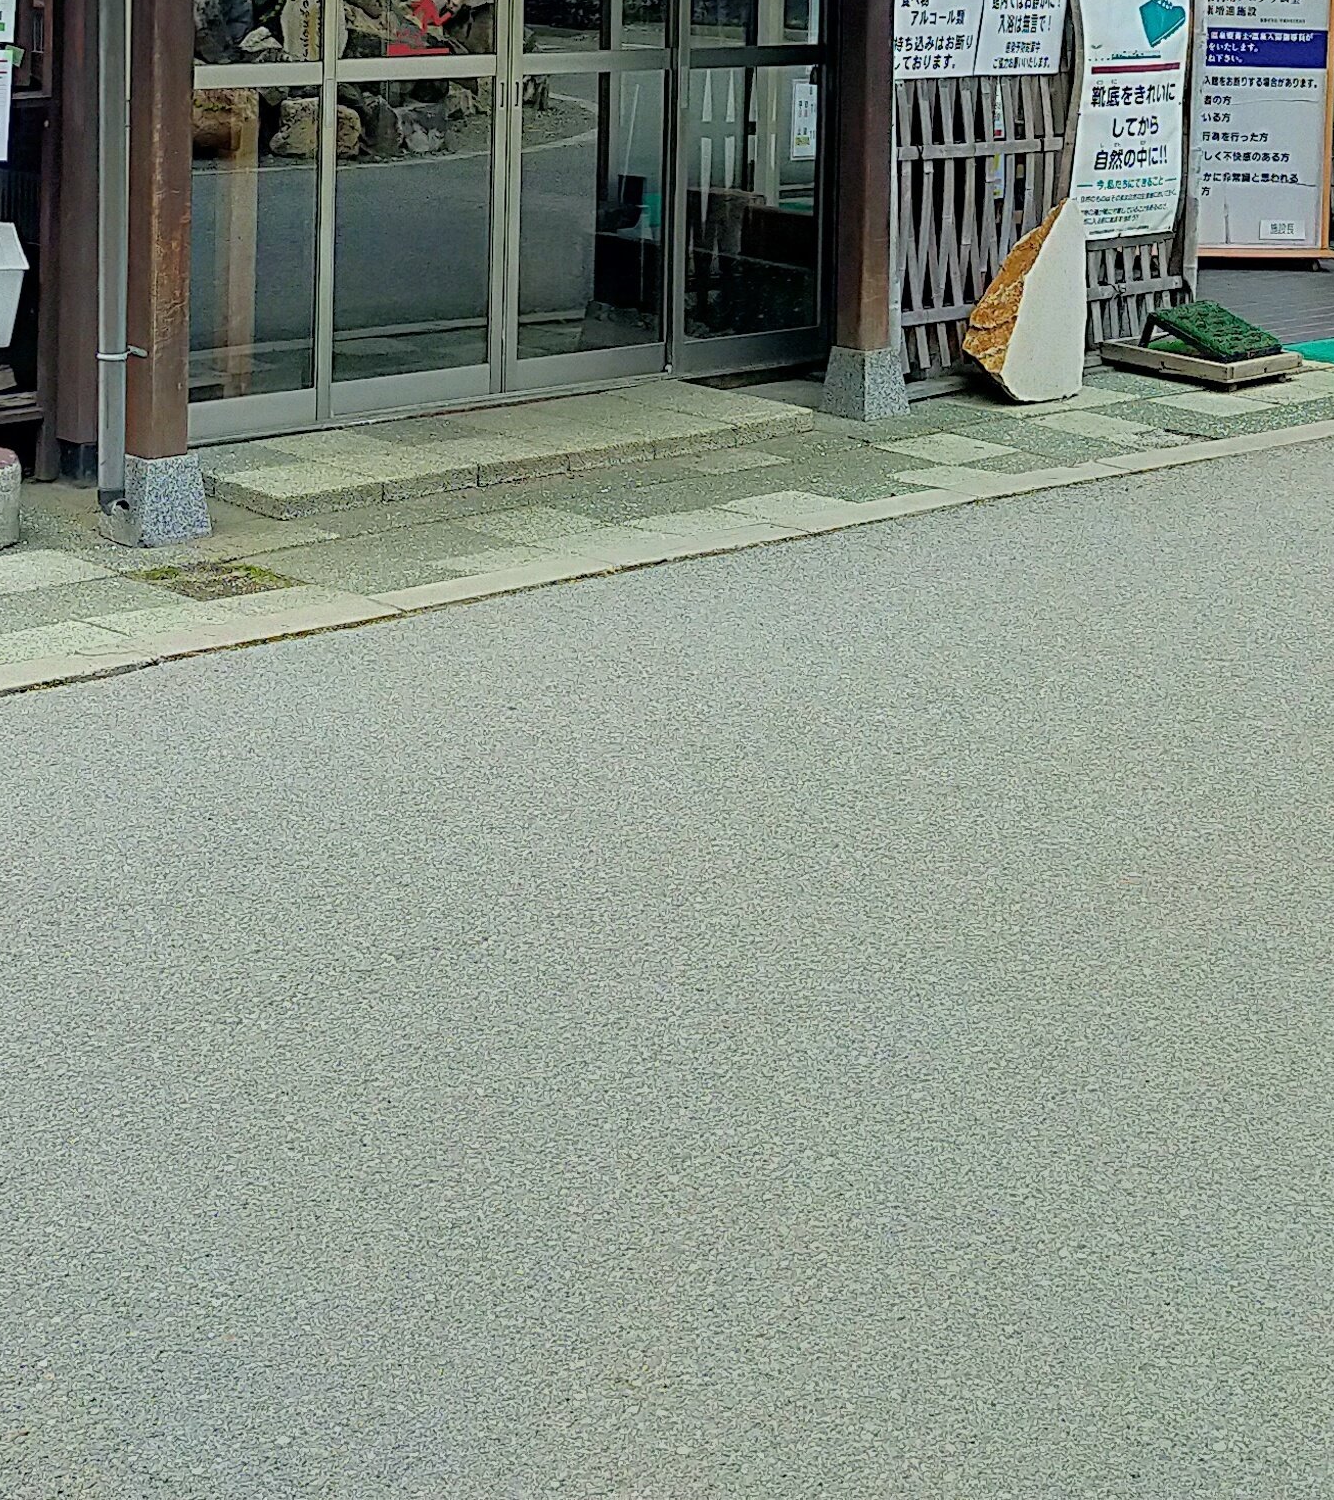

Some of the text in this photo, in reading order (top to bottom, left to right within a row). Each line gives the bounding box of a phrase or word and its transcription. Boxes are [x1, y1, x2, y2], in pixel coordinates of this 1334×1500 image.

[911, 10, 966, 26] アルコール類
[1091, 83, 1176, 107] 靴底をきれいに
[1112, 116, 1159, 138] してから
[1202, 132, 1268, 142] 行為を行った方
[1201, 186, 1211, 197] 方
